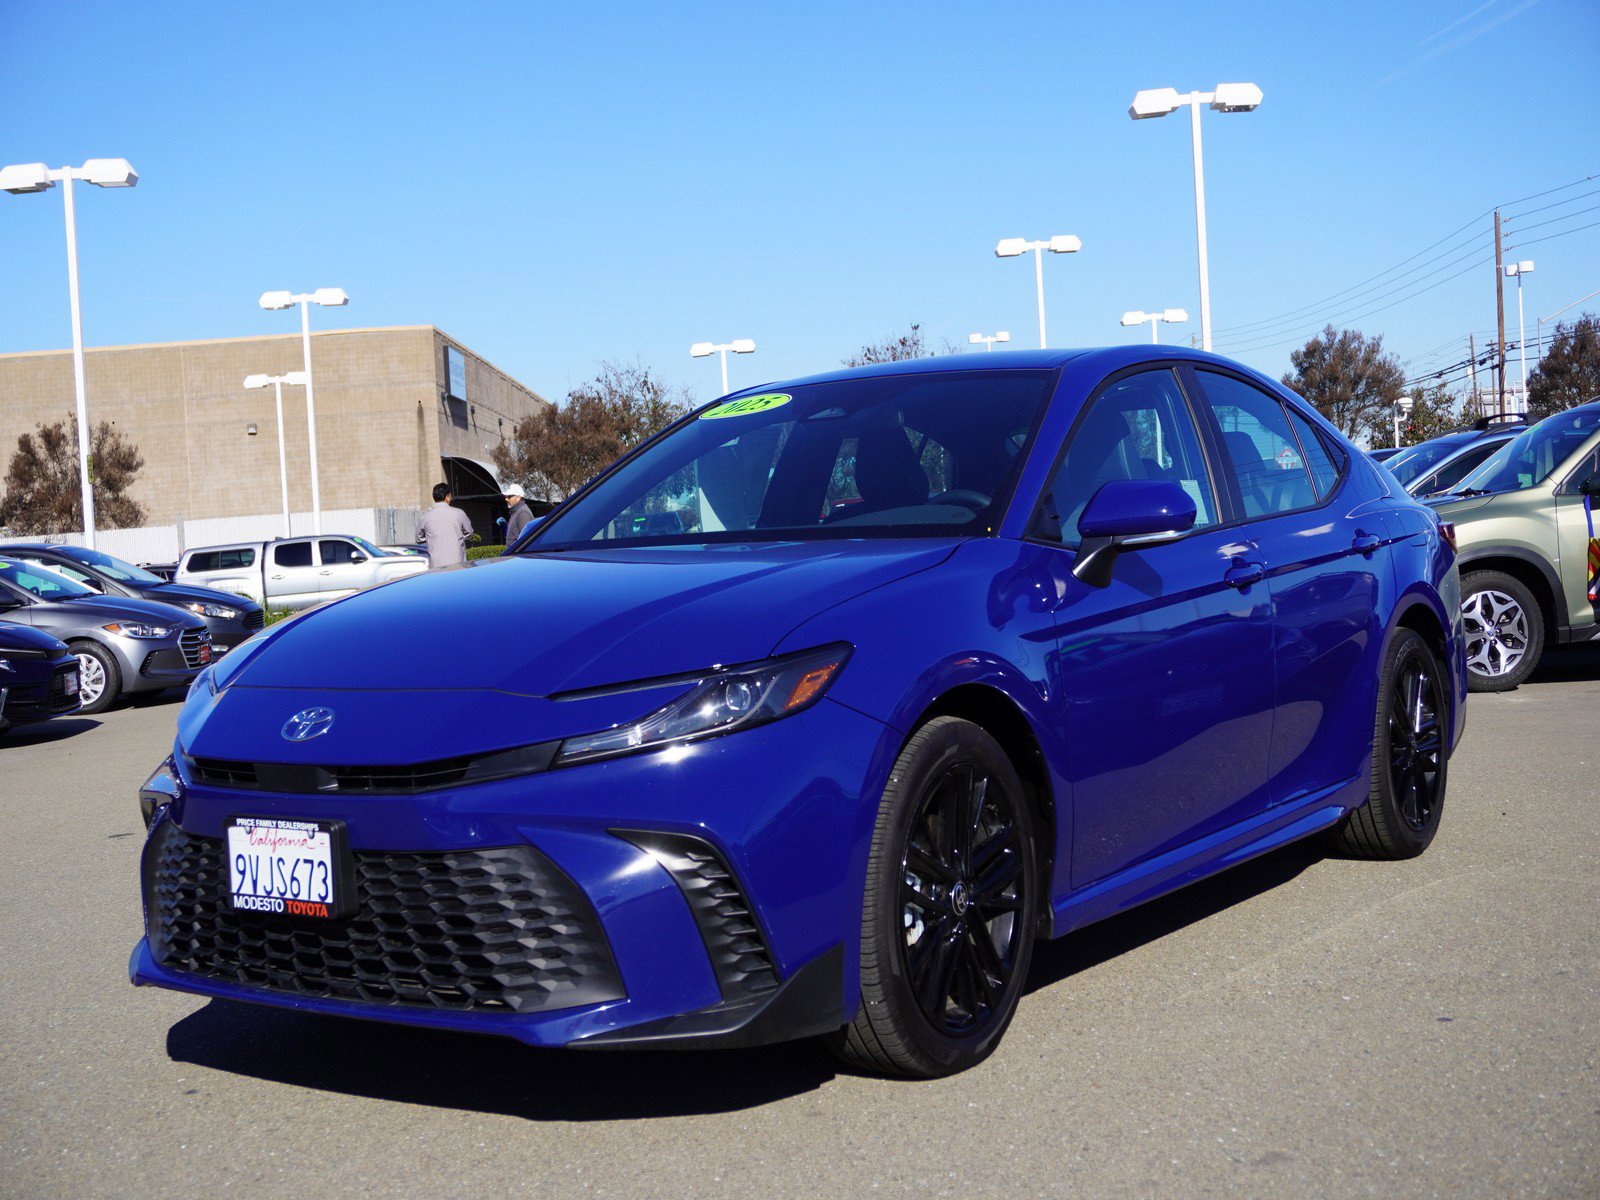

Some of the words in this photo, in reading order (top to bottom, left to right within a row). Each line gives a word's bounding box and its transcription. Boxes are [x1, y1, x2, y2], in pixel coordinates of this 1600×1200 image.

[709, 396, 782, 416] 2025
[236, 818, 256, 827] PRICE
[256, 819, 277, 828] FAMILY
[277, 821, 319, 832] DEALERSHIPS
[249, 826, 315, 853] California
[235, 853, 329, 902] 9VJS673
[233, 894, 284, 913] MODESTO
[286, 900, 329, 917] TOYOTA
